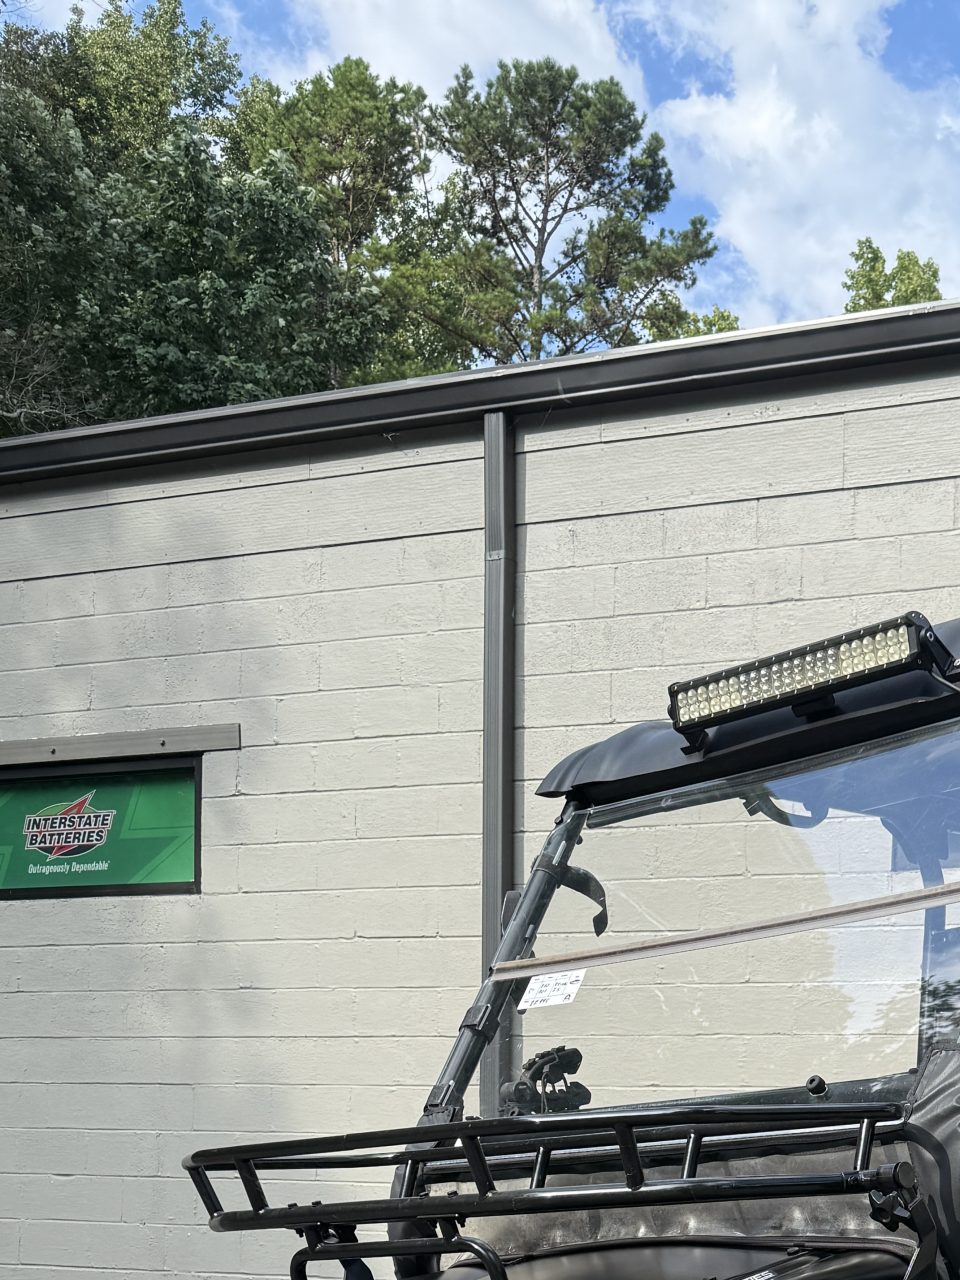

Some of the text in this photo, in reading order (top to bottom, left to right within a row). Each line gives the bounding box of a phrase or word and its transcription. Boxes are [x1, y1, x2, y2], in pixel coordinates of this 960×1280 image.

[26, 814, 110, 830] INTERSTATE
[28, 830, 105, 846] BATTERIES
[28, 863, 69, 874] Outrageously
